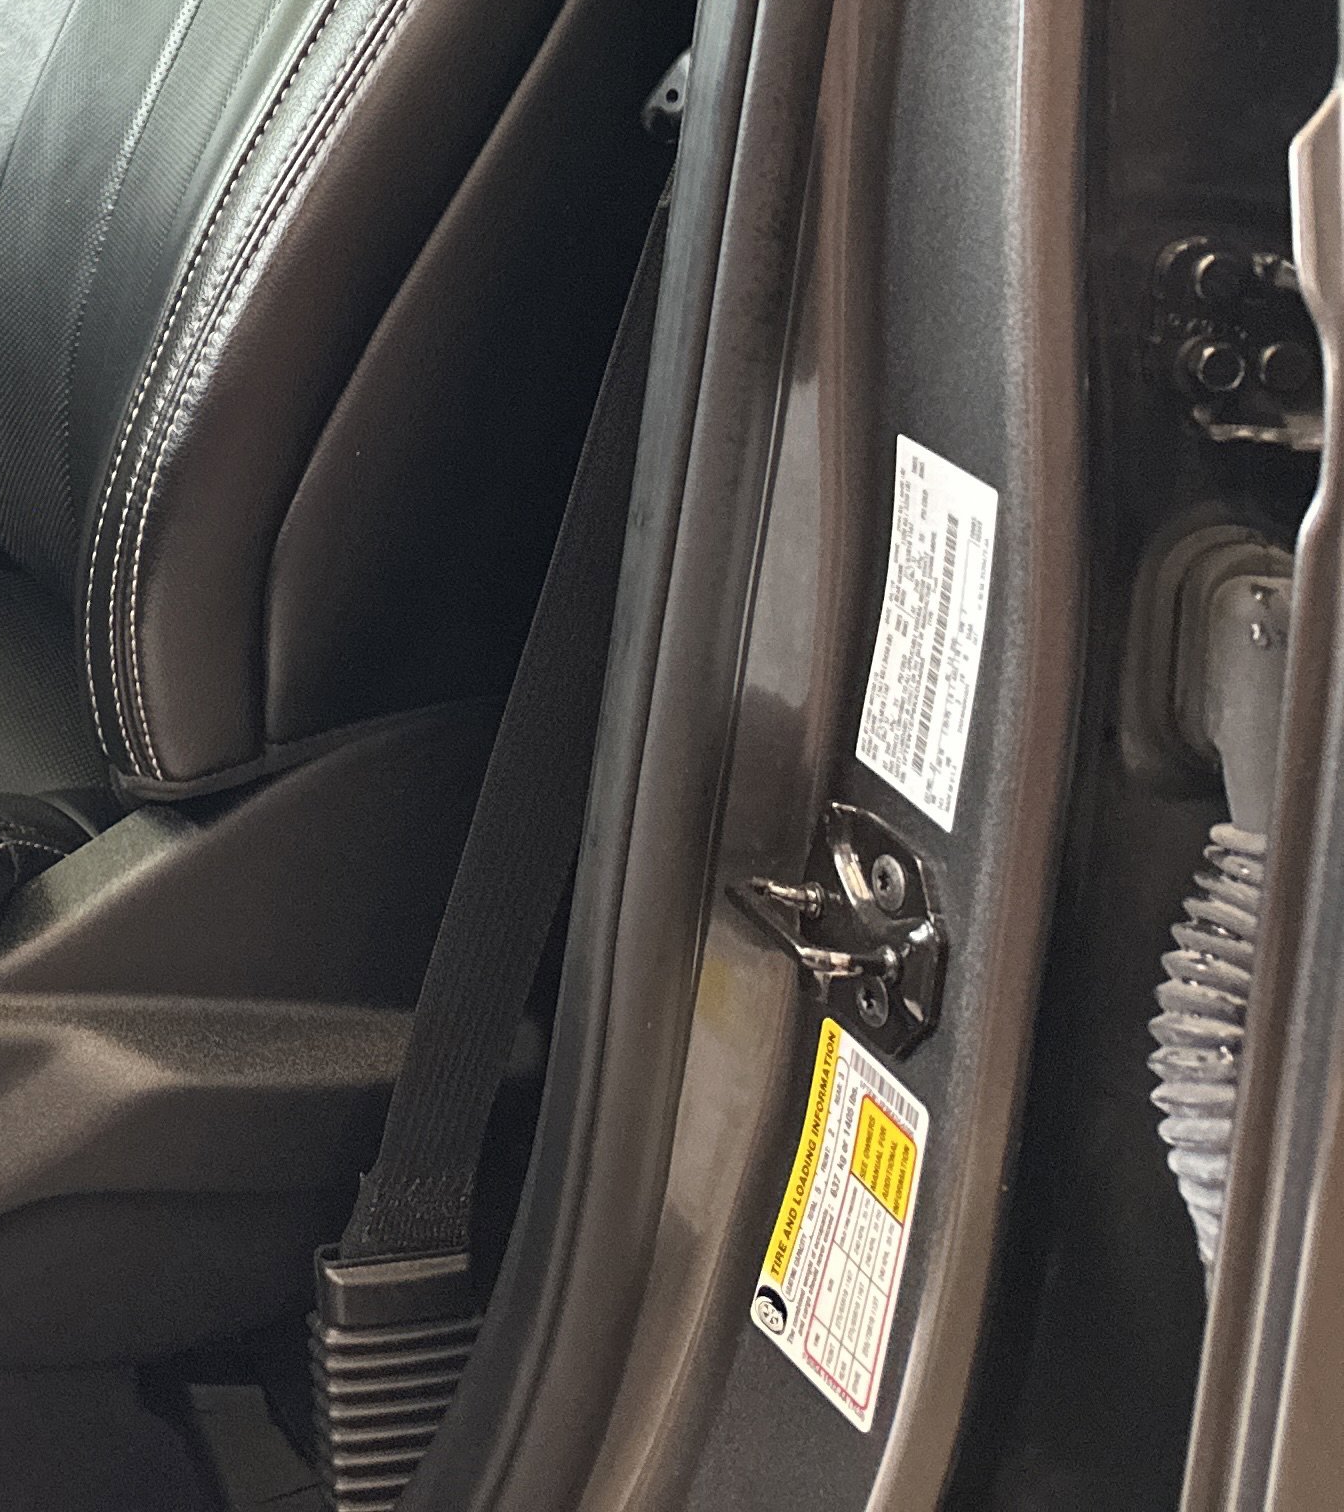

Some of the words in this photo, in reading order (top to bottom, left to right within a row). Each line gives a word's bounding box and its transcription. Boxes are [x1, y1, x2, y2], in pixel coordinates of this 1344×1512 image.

[770, 1240, 786, 1276] TIRE
[783, 1206, 796, 1239] AND
[793, 1138, 815, 1205] LOADING
[811, 1030, 835, 1135] INFORMATION
[837, 1154, 846, 1170] kg
[841, 1139, 848, 1153] or
[871, 1149, 881, 1191] MANUAL
[882, 1139, 896, 1200] ADDITIONAL
[893, 1143, 908, 1214] INFORMATION
